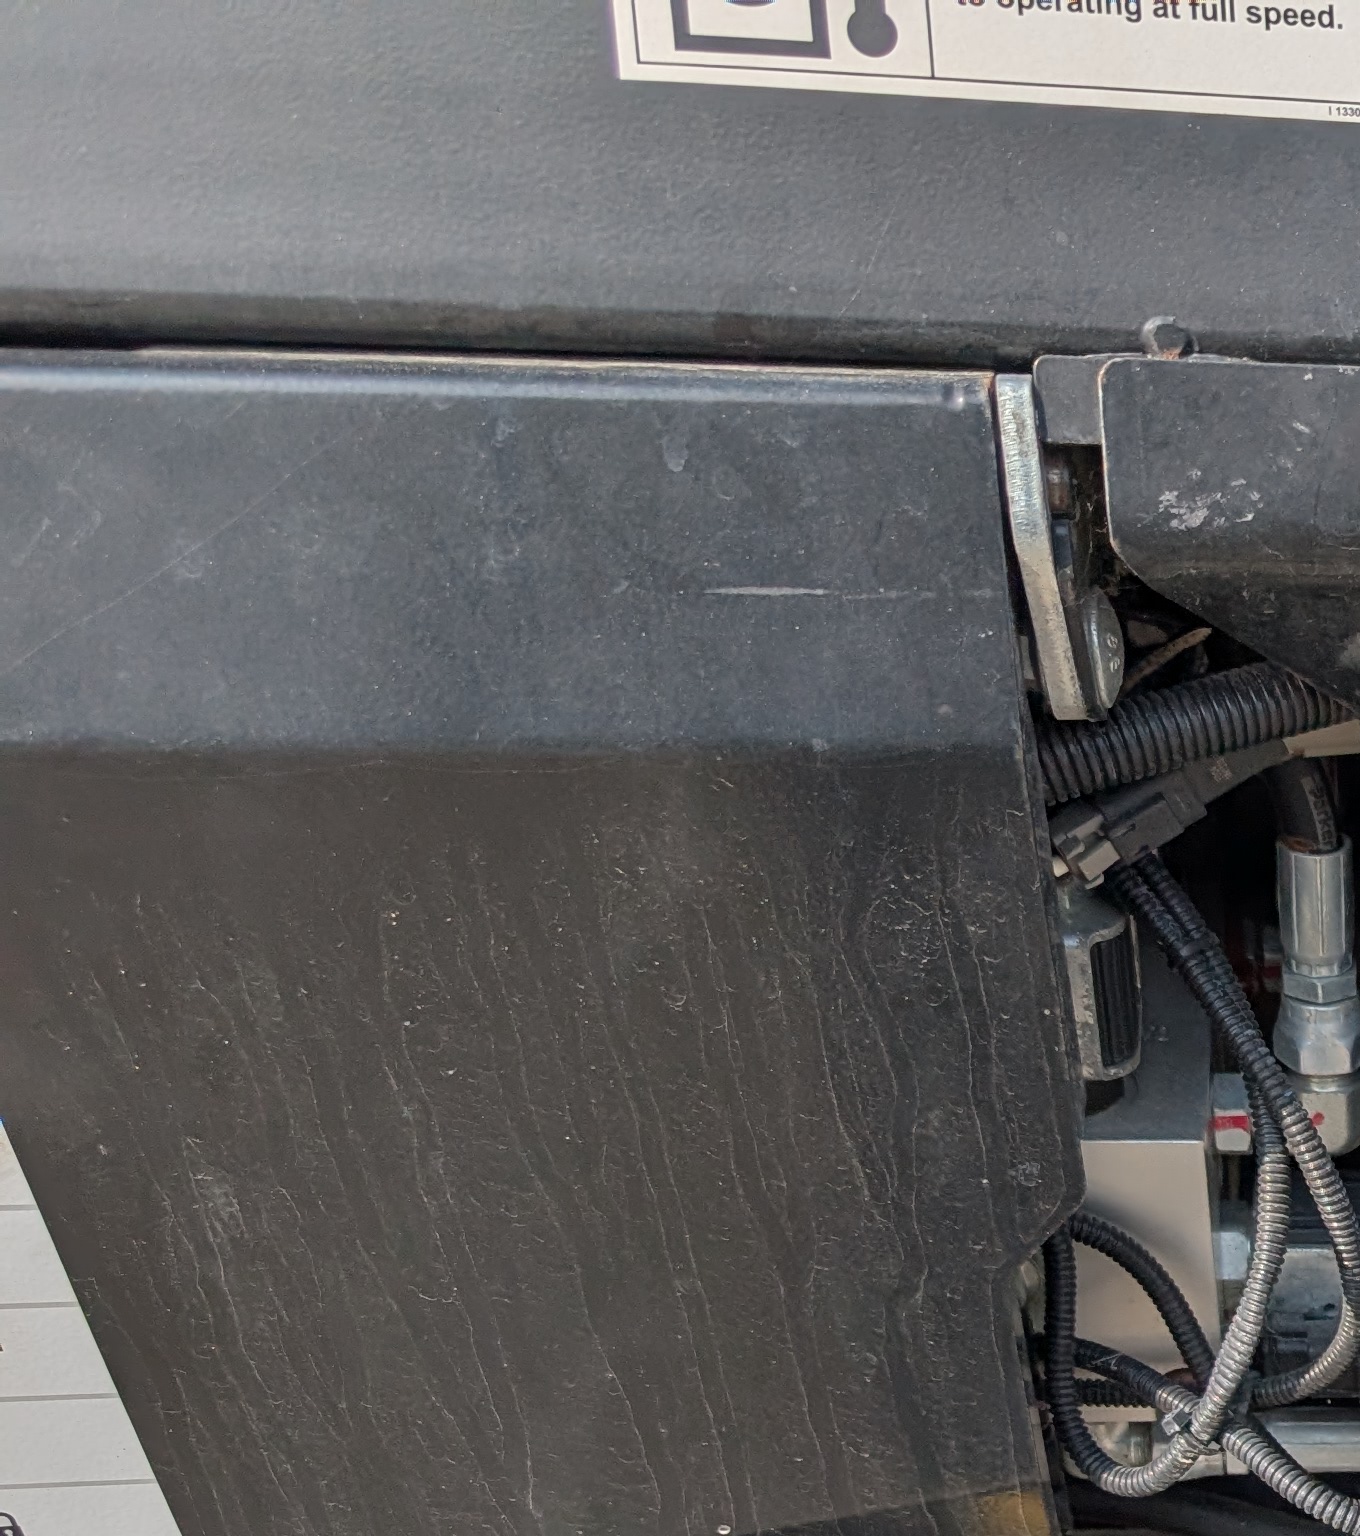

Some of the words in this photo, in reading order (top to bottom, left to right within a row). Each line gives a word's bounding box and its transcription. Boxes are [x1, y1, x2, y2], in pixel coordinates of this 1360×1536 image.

[1153, 0, 1181, 19] at
[1190, 0, 1236, 23] full
[1246, 4, 1343, 31] speed.
